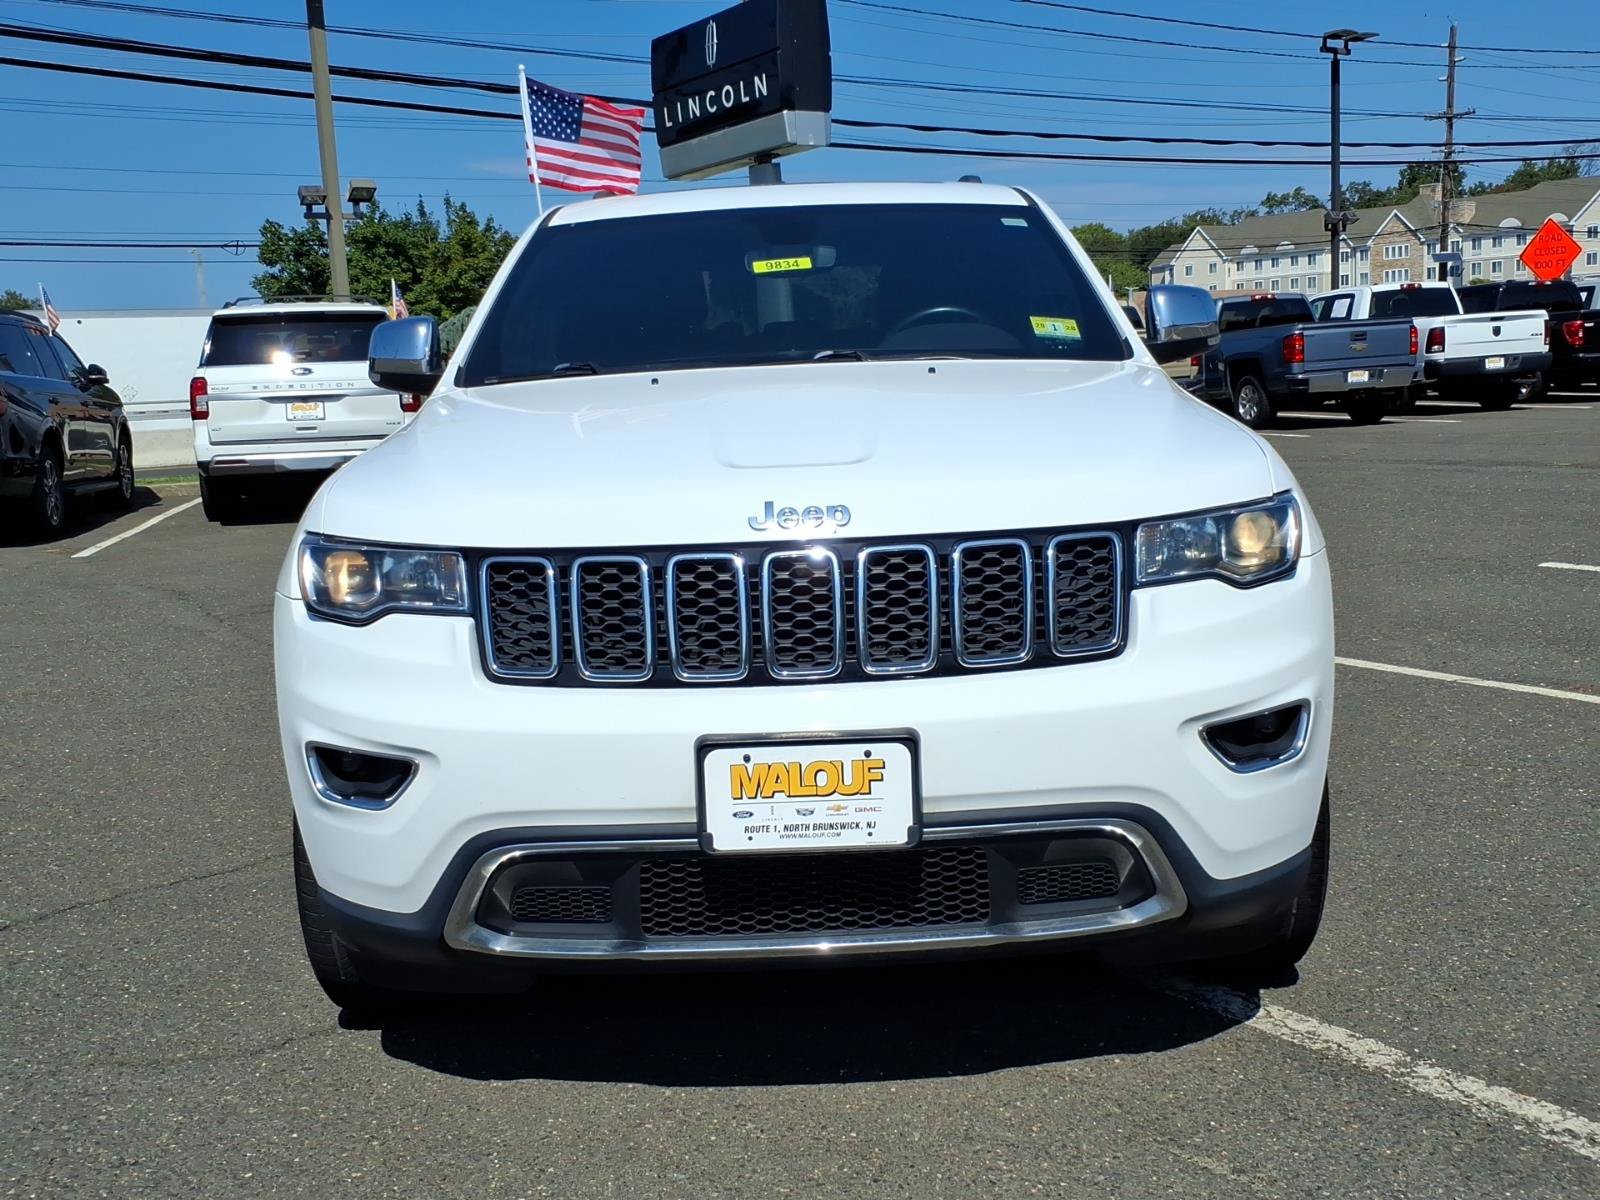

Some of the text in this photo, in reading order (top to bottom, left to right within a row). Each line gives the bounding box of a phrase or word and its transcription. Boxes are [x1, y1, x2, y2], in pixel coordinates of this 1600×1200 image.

[664, 73, 768, 128] LINCOLN
[1538, 233, 1563, 244] ROAD
[1534, 246, 1567, 256] CLOSED
[765, 259, 801, 271] 9834
[1556, 258, 1566, 268] FT
[252, 382, 355, 390] EXPEDITION
[748, 500, 851, 534] Jeep
[730, 759, 886, 799] MALOUF
[744, 820, 877, 834] ROUTE 1, NORTH BRUNSWICK, NJ
